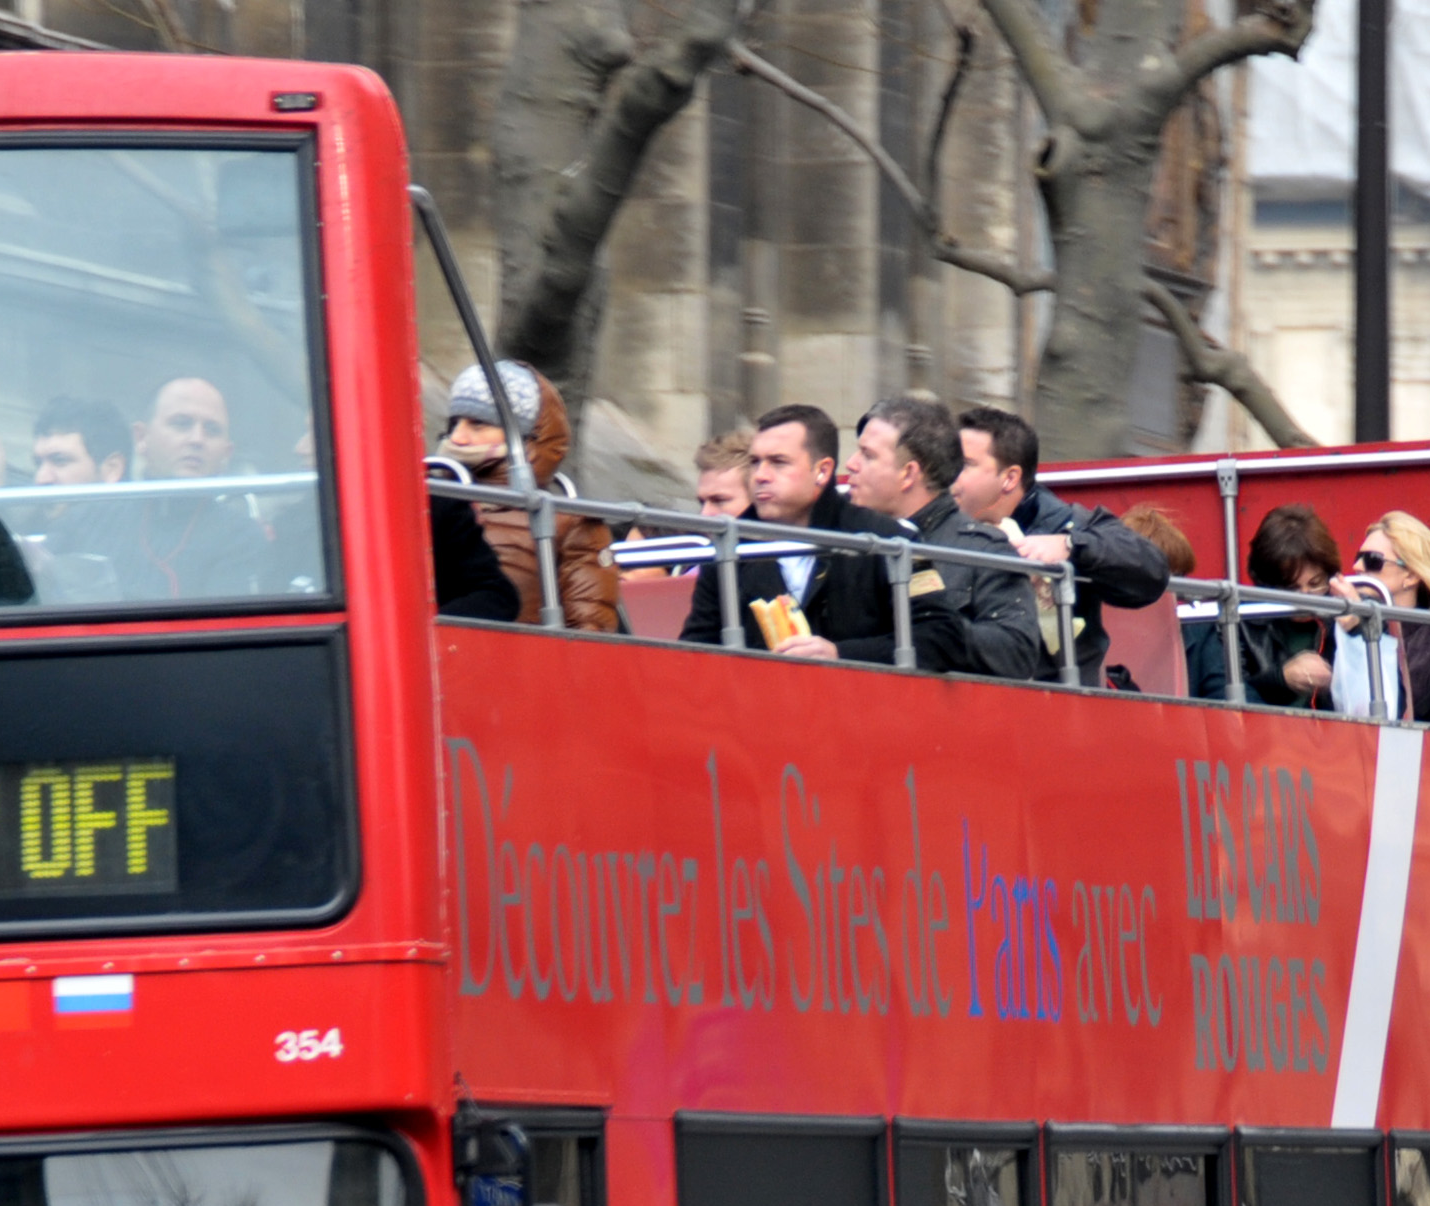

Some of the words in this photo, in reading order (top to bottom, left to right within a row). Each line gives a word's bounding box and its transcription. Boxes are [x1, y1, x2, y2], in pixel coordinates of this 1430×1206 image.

[20, 761, 175, 880] OFF
[447, 735, 701, 1004] Découvrez
[705, 746, 773, 1011] les
[779, 760, 891, 1016] Sites
[902, 763, 954, 1018] de
[962, 812, 1064, 1024] Paris
[1071, 877, 1163, 1027] avec
[1175, 757, 1234, 923] LES
[1241, 764, 1323, 926] CARS
[274, 1026, 345, 1063] 354
[1189, 951, 1331, 1076] ROUGES
